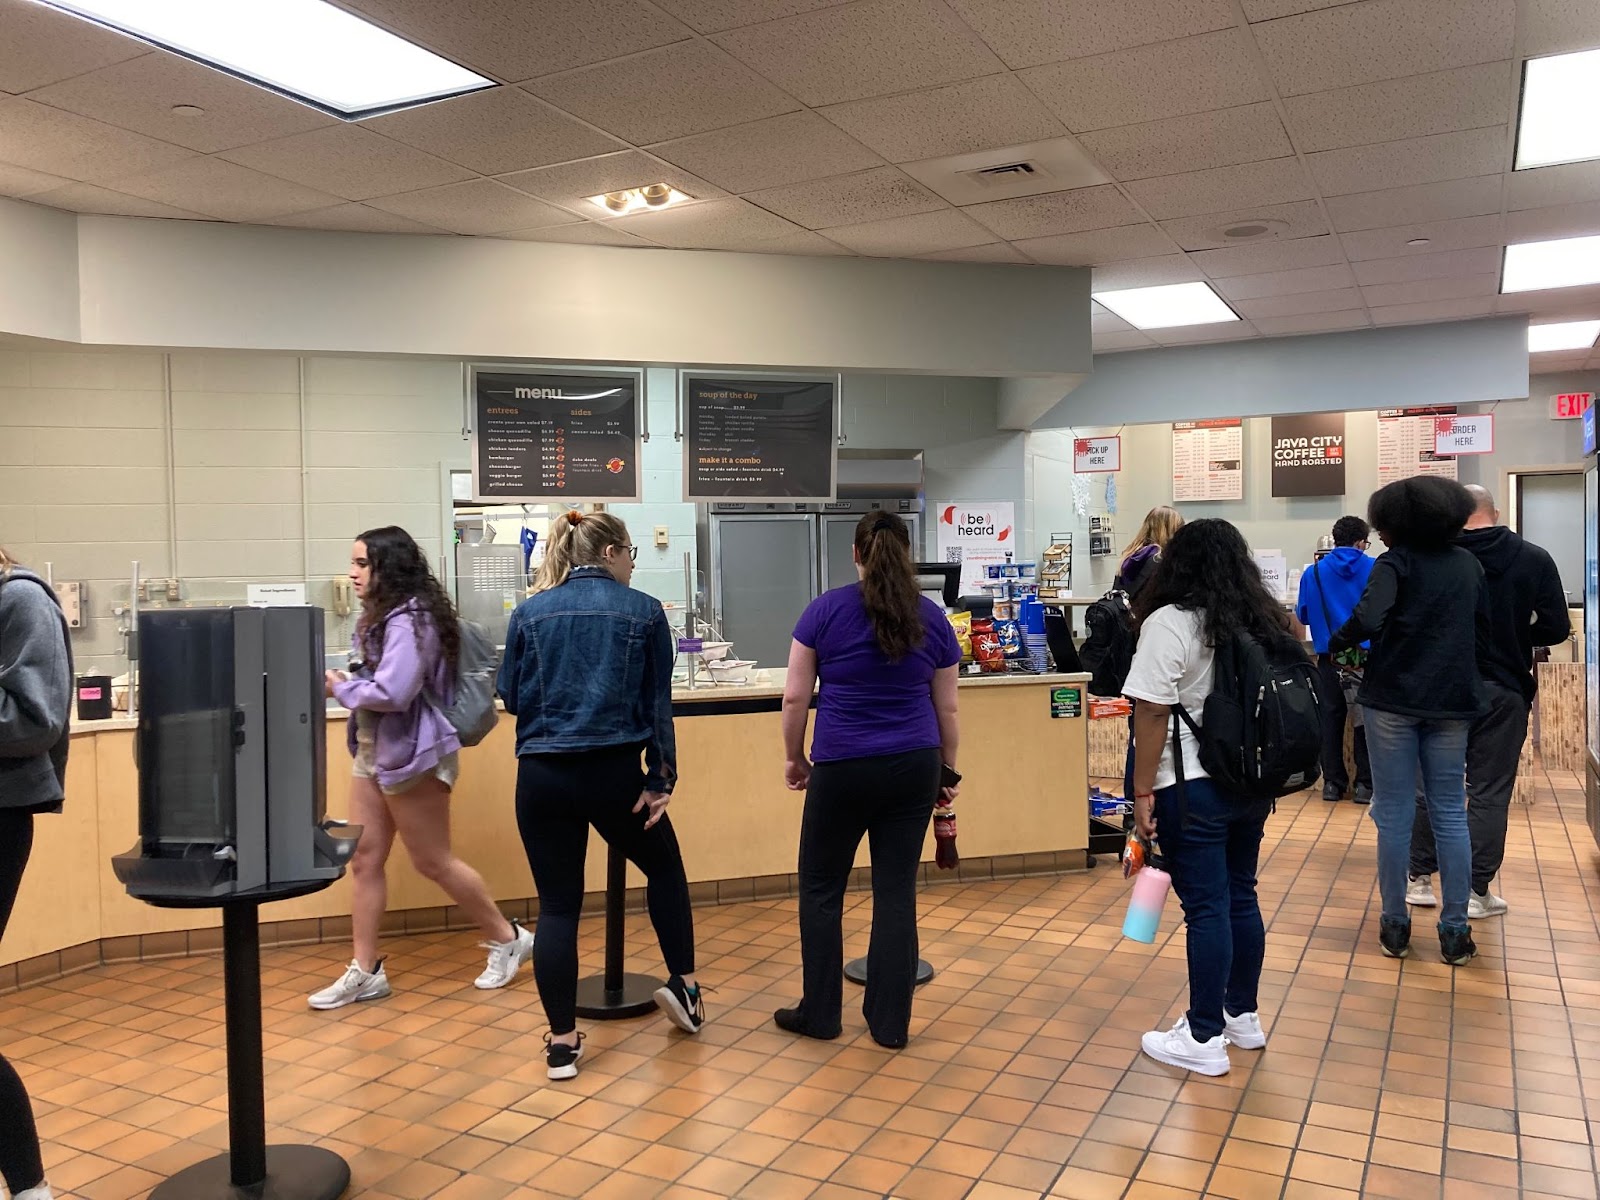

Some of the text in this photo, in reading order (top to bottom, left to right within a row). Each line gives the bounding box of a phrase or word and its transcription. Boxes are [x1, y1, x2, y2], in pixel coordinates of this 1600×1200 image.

[515, 388, 562, 399] menu
[1558, 394, 1589, 416] EXIT
[1452, 425, 1476, 434] ORDER
[1275, 436, 1342, 449] JAVA CITY
[1455, 437, 1474, 446] HERE
[1274, 448, 1325, 459] COFFEE
[968, 514, 984, 525] be
[958, 525, 994, 535] heard
